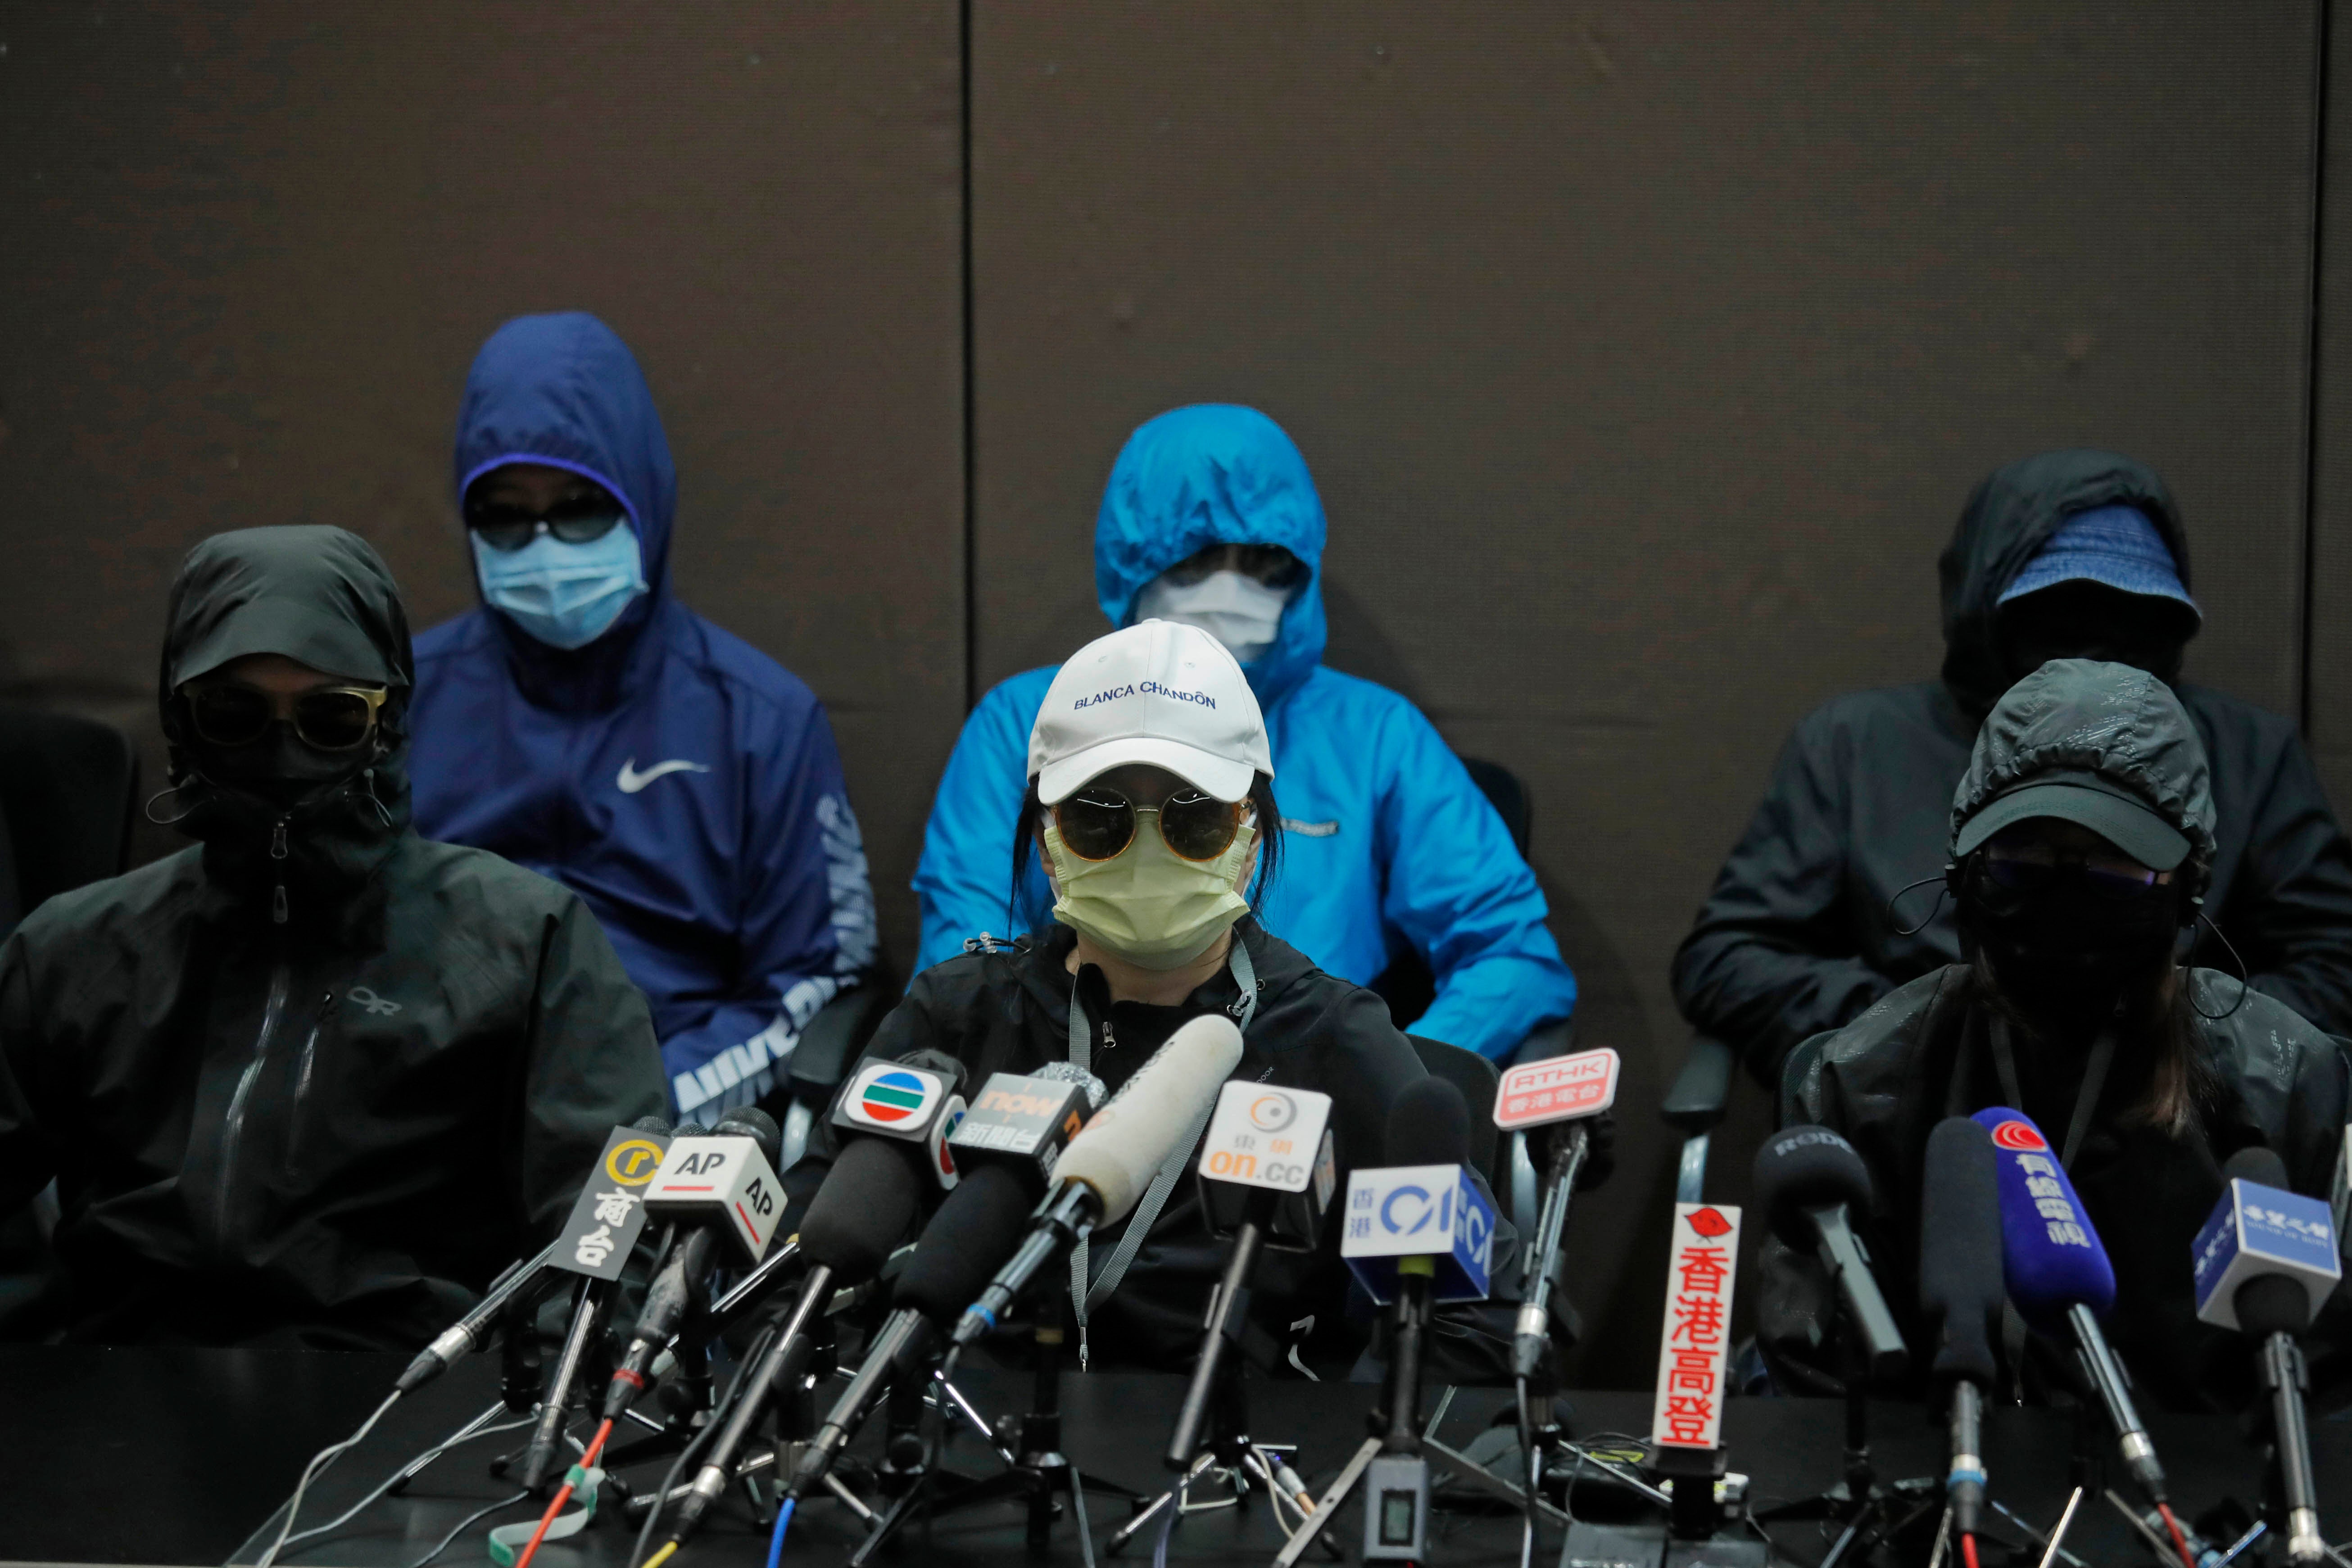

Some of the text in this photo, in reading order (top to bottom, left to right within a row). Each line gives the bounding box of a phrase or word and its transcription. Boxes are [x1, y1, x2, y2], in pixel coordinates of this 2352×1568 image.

[1074, 684, 1135, 710] BLANCA
[1515, 1060, 1601, 1088] RTHK
[979, 1090, 1064, 1118] now
[957, 1122, 1042, 1150] 新聞台
[675, 1153, 725, 1175] AP
[1209, 1151, 1304, 1185] on.cc
[746, 1177, 773, 1216] AP
[576, 1187, 640, 1268] 商台
[1661, 1246, 1729, 1446] 香港高登
